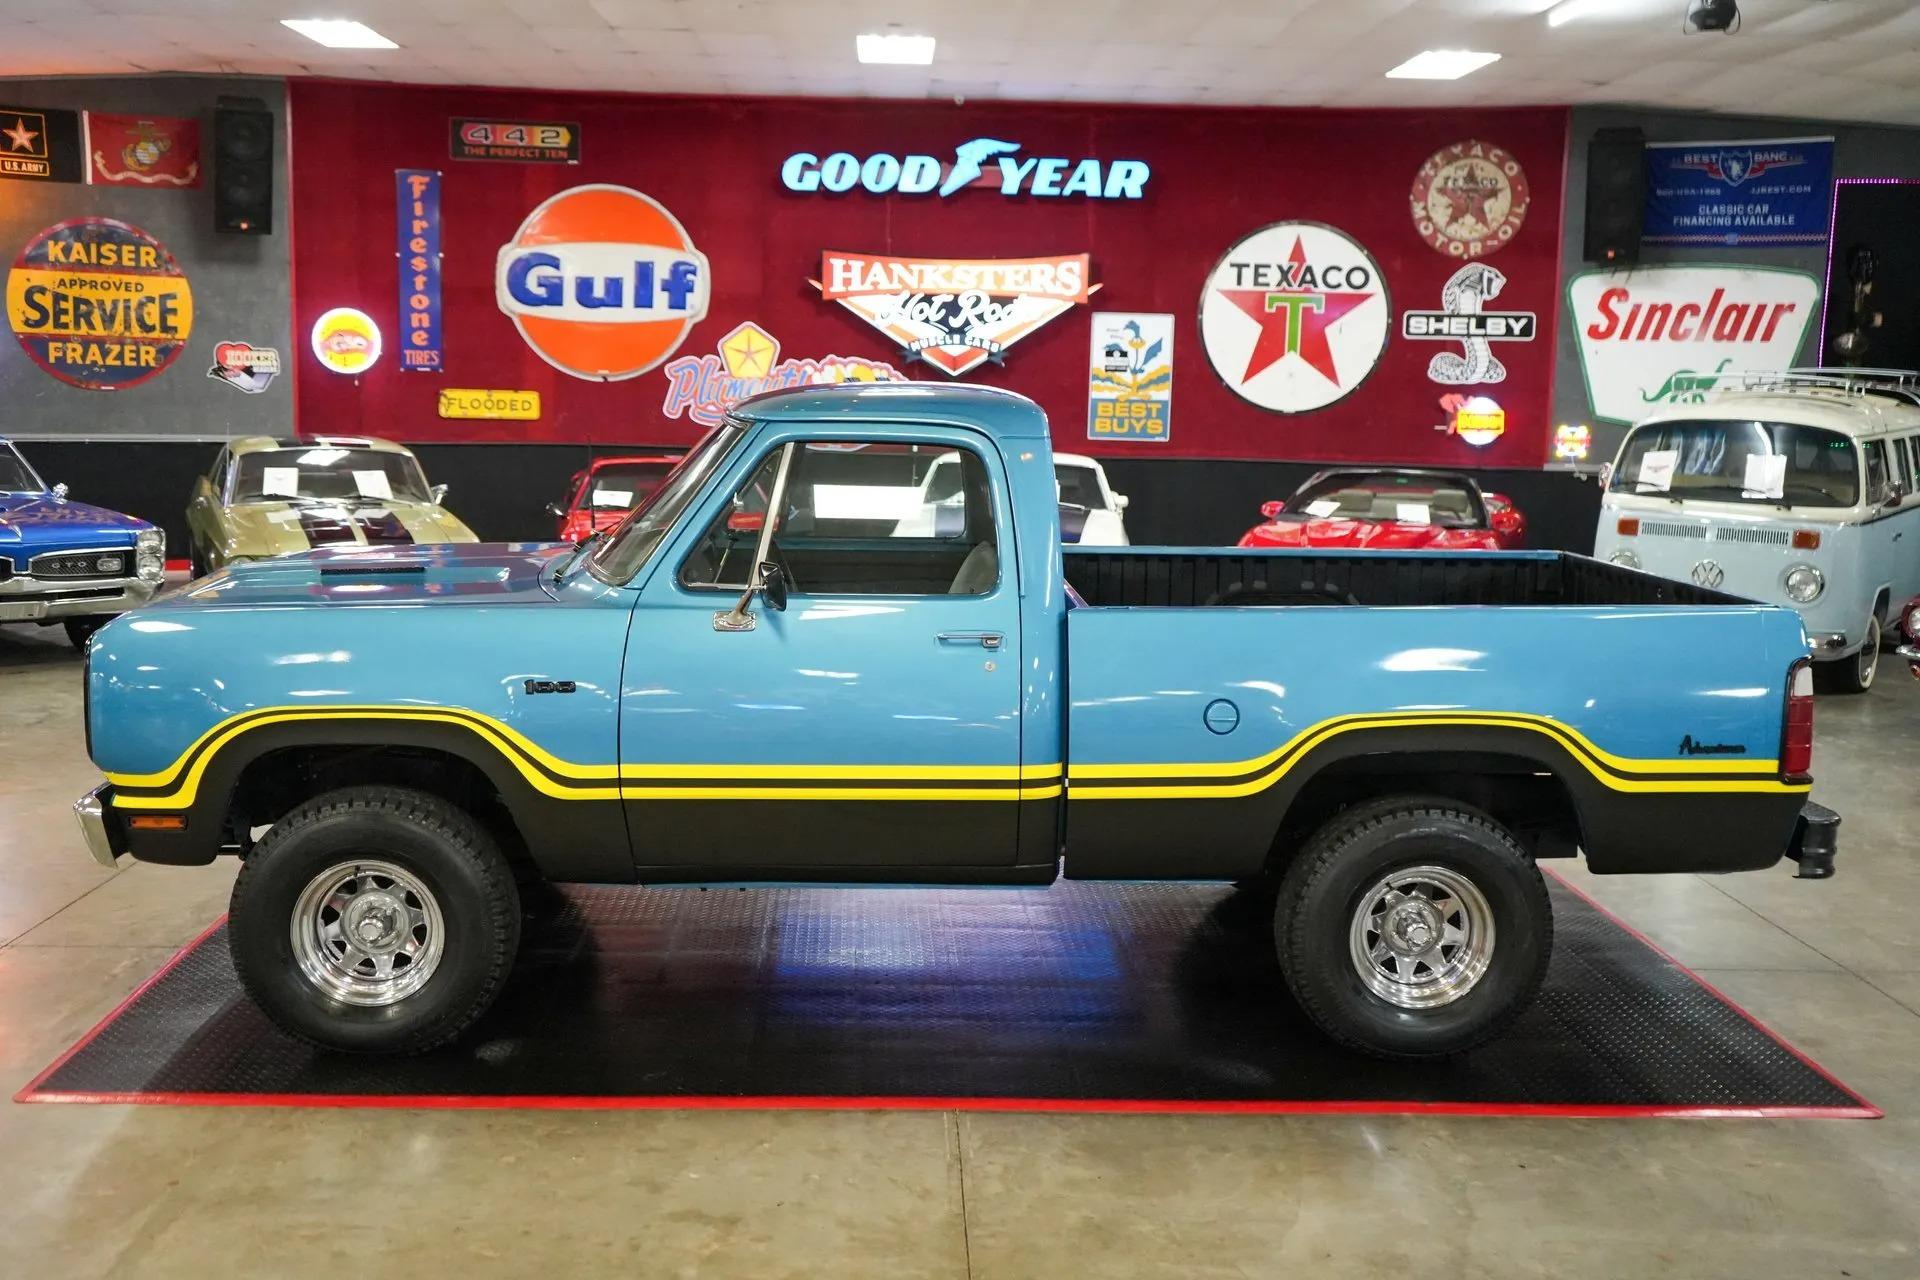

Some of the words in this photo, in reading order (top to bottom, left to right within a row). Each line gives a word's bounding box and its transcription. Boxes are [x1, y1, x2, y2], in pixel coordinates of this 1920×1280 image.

[463, 146, 485, 156] THE
[489, 147, 540, 158] PERFECT
[544, 150, 568, 159] TEN
[1684, 153, 1718, 164] BEST
[21, 162, 44, 173] ARMY
[1698, 204, 1744, 215] CLASSIC
[1747, 204, 1769, 215] CAR
[1673, 215, 1732, 227] FINANCING
[1734, 214, 1795, 226] AVAILABLE
[48, 240, 158, 268] KAISER
[406, 174, 431, 347] Firestone
[507, 252, 698, 311] Gulf
[829, 258, 1083, 297] HANKSTERS
[1229, 262, 1371, 290] TEXACO
[56, 278, 144, 293] APPROVED
[23, 285, 179, 335] SERVICE
[1587, 287, 1796, 344] Sinclair
[1408, 315, 1530, 337] SHELBY
[48, 342, 157, 367] FRAZER
[403, 350, 440, 365] TIRES
[446, 397, 533, 412] FLOODED
[1097, 401, 1162, 418] BEST
[1095, 417, 1164, 435] BUYS
[51, 561, 87, 569] GTO
